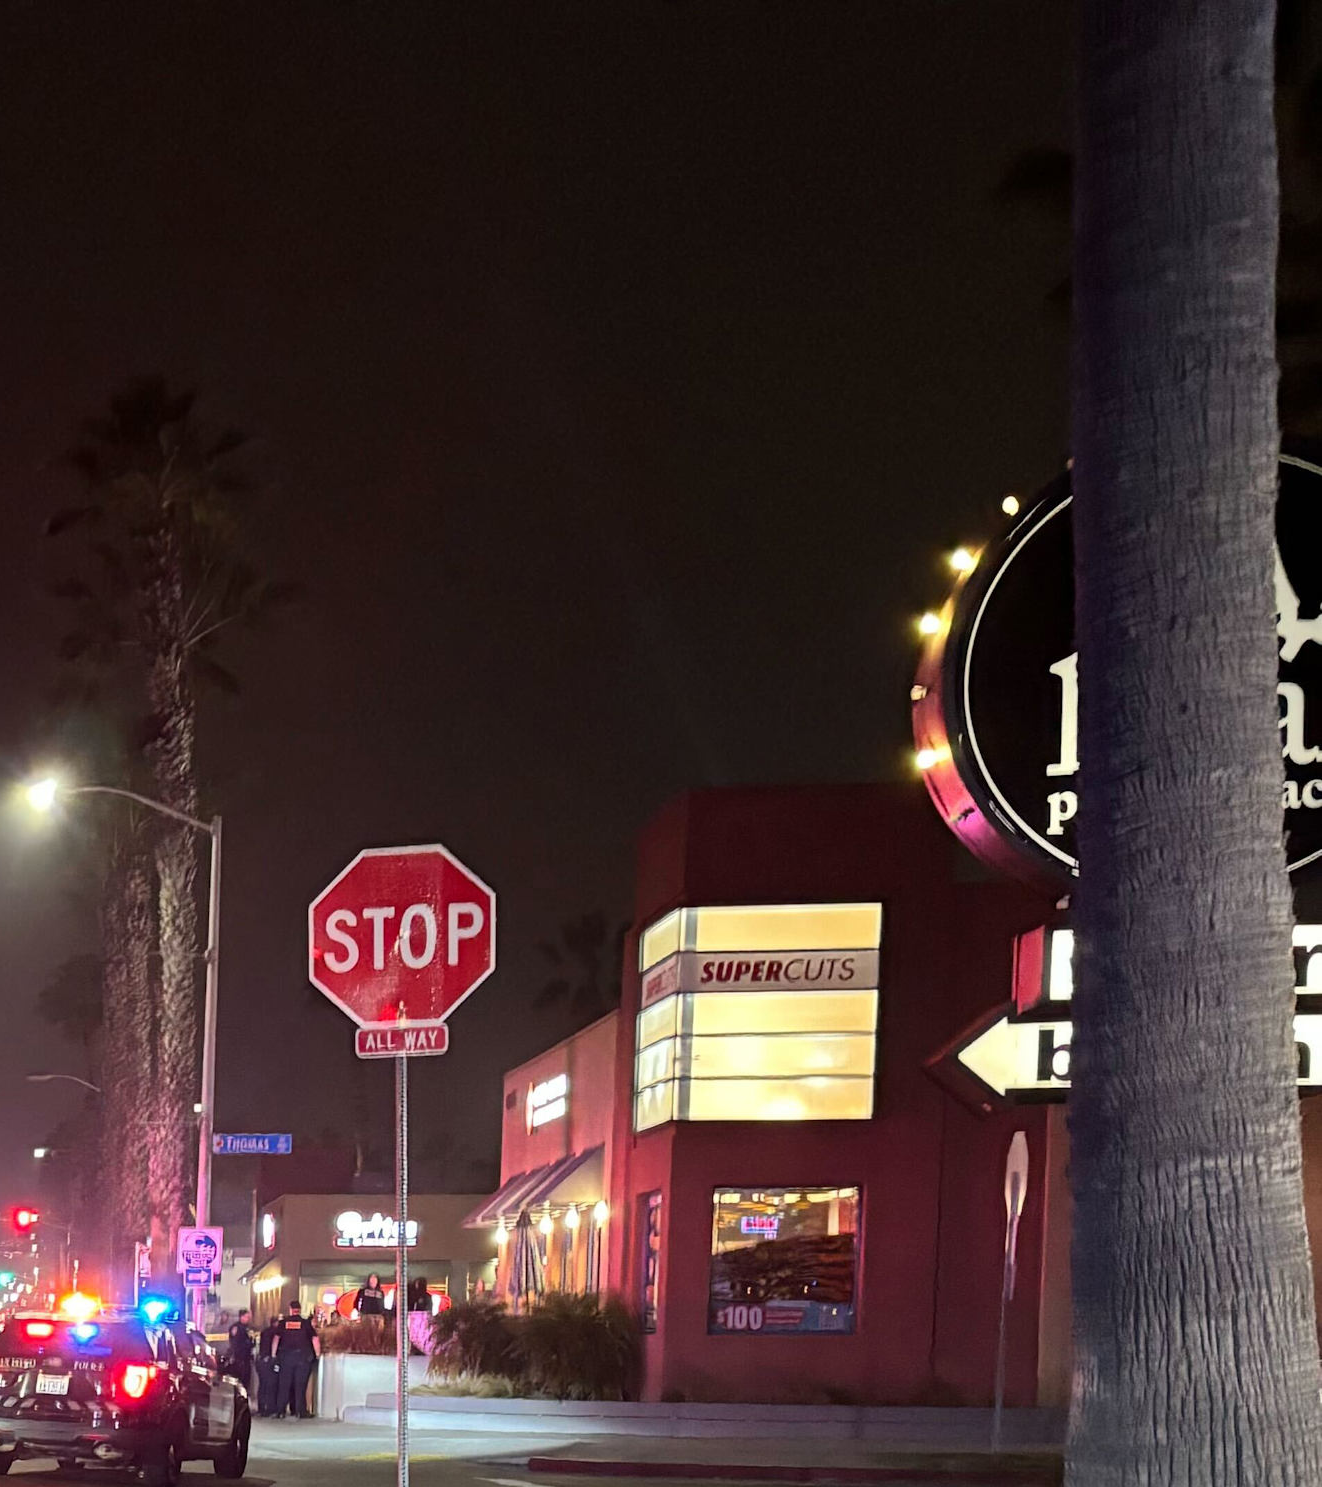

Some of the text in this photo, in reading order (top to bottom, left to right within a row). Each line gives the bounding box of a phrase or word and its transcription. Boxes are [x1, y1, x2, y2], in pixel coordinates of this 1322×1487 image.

[323, 902, 484, 974] STOP
[701, 957, 855, 984] SUPERCUTS
[365, 1030, 438, 1050] ALL WAY
[716, 1305, 763, 1331] $100
